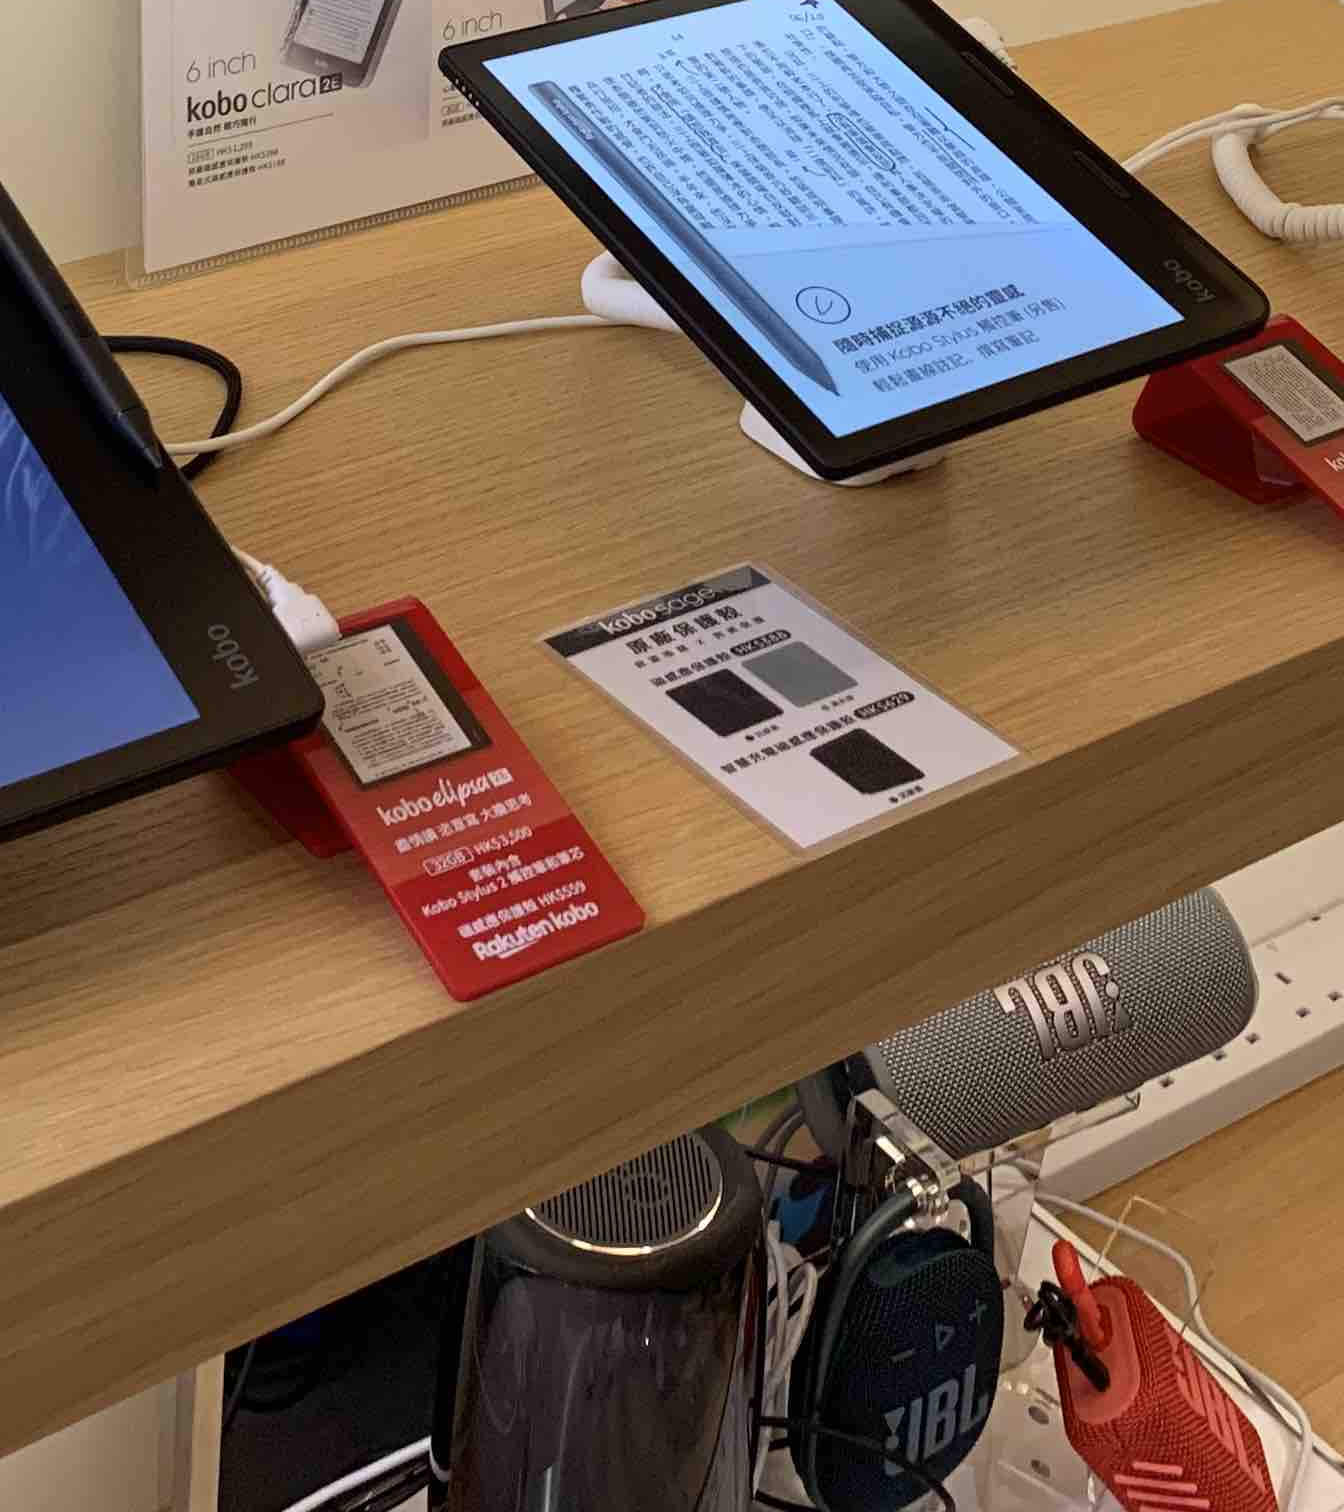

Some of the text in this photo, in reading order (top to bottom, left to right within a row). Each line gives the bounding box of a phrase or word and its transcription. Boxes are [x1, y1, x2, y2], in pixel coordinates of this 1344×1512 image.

[443, 7, 503, 41] 6 inch
[186, 50, 256, 84] 6 inch
[187, 89, 247, 123] kobo
[251, 77, 317, 109] clara
[1164, 259, 1217, 304] kobo
[599, 586, 718, 636] kobo sage
[207, 624, 259, 689] kobo
[376, 794, 433, 827] kobo
[432, 774, 490, 808] elipsa
[421, 897, 458, 918] Kobo
[456, 882, 498, 905] Stylus
[472, 901, 600, 961] Rakuten kobo
[993, 952, 1119, 1061] JBL
